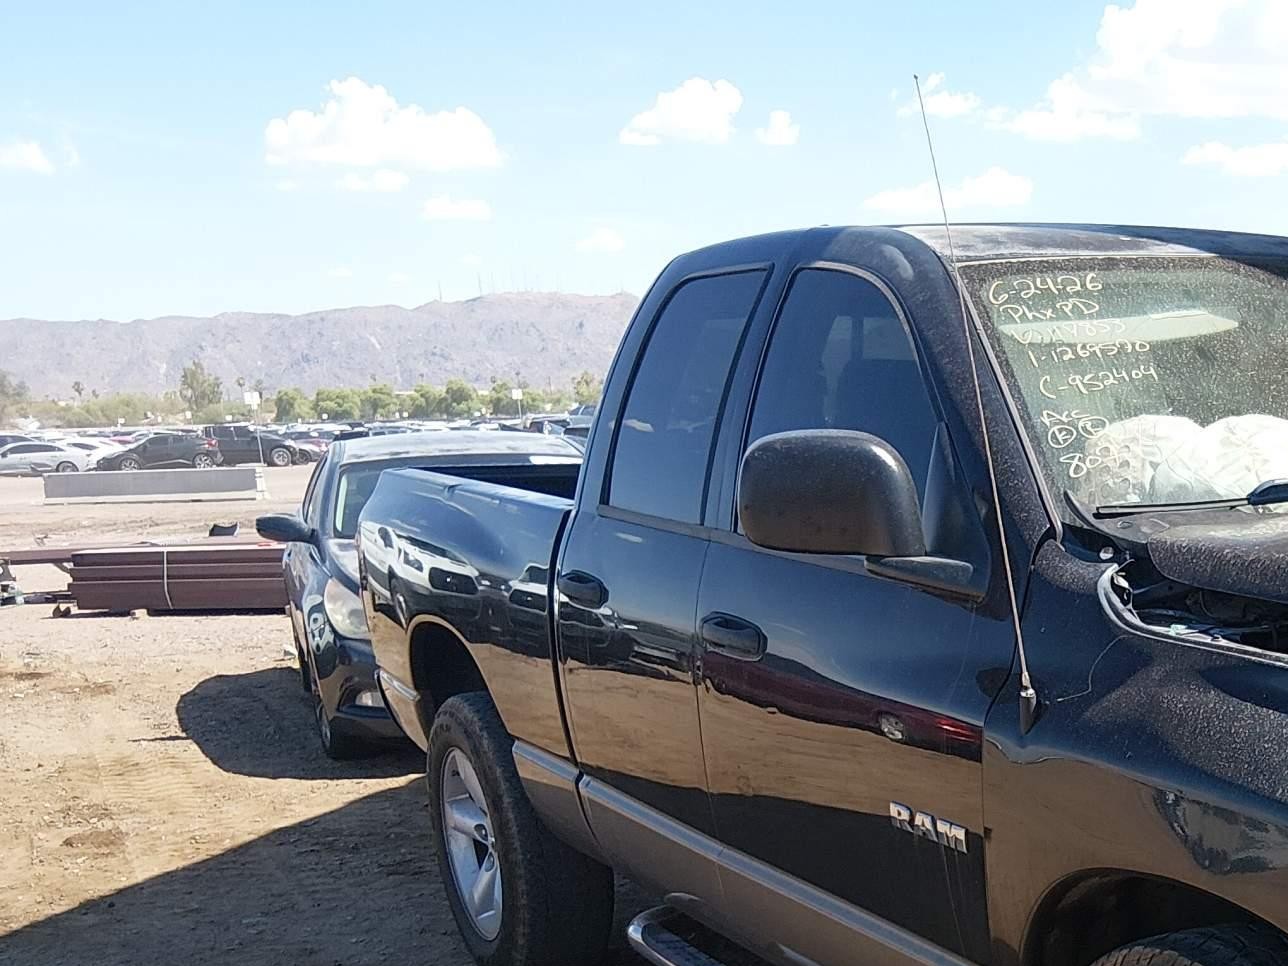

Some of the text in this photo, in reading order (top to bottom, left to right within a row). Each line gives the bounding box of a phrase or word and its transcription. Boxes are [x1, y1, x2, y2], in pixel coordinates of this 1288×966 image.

[988, 273, 1103, 305] 6-24-26
[1000, 298, 1099, 324] Phx PD
[1039, 364, 1159, 399] C-952404
[889, 800, 968, 854] RAM
